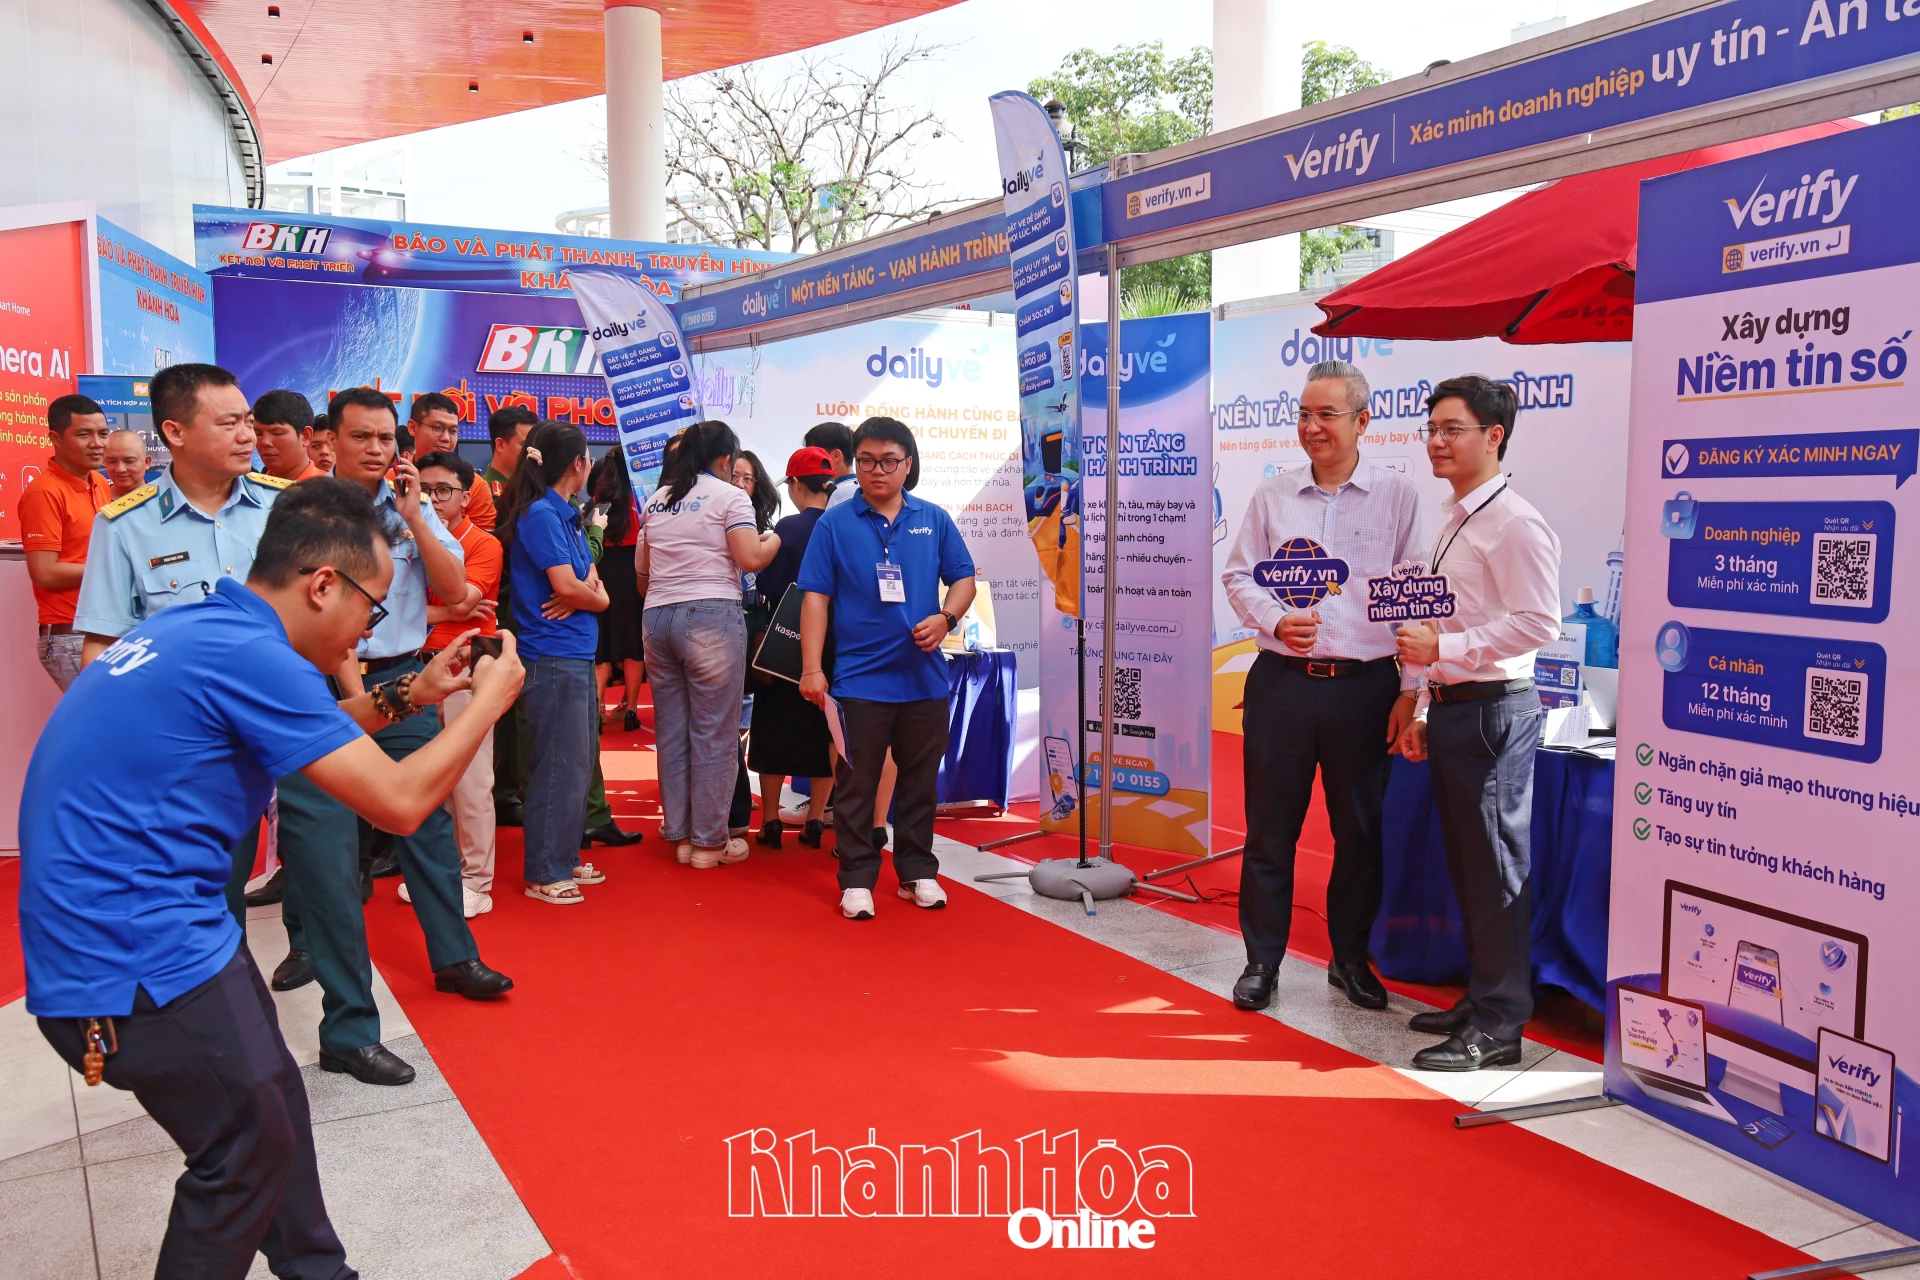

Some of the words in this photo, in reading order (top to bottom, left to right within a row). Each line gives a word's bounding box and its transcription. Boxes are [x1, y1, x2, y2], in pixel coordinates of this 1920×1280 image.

[1410, 117, 1444, 145] Xác
[1447, 105, 1495, 137] minh
[1498, 86, 1562, 124] doanh
[1567, 66, 1645, 108] nghiệp
[1652, 42, 1701, 87] uy
[1711, 20, 1766, 68] tín
[1283, 130, 1381, 182] Verify
[1145, 184, 1192, 210] verify.vn
[1722, 168, 1859, 231] Verify
[393, 231, 447, 253] BÁO
[454, 236, 488, 257] VÀ
[495, 239, 555, 261] PHÁT
[560, 247, 642, 269] THANH,
[649, 248, 725, 274] TRUYỀN
[1750, 237, 1820, 263] verify.vn
[97, 232, 114, 262] BÁO
[114, 241, 127, 268] VÀ
[127, 248, 146, 278] PHÁT
[191, 280, 206, 306] HÌNH
[791, 278, 815, 306] MỘT
[817, 270, 841, 298] NỀN
[842, 263, 876, 292] TẢNG
[889, 256, 918, 285] VẠN
[920, 241, 962, 276] HÀNH
[11, 302, 31, 317] Home
[136, 286, 163, 318] KHÁNH
[164, 298, 180, 326] HÒA
[701, 311, 715, 324] 0155
[1721, 311, 1770, 344] Xây
[1776, 306, 1850, 339] dựng
[50, 348, 71, 380] AI
[1677, 351, 1775, 396] Niềm
[1786, 342, 1842, 387] tin
[1850, 330, 1913, 382] số
[5, 389, 21, 404] sản
[23, 391, 48, 408] phẩm
[107, 398, 122, 406] TÍCH
[620, 392, 635, 402] GIAO
[15, 410, 37, 426] hành
[816, 401, 860, 417] LUÔN
[865, 402, 910, 419] ĐỒNG
[915, 404, 958, 420] HÀNH
[962, 405, 1003, 421] CÙNG
[1219, 393, 1262, 428] NỀN
[15, 431, 37, 447] quốc
[928, 424, 988, 440] CHUYẾN
[992, 428, 1008, 441] ĐI
[1136, 429, 1185, 453] TẢNG
[1239, 438, 1260, 453] tảng
[1262, 438, 1278, 452] đặt
[1280, 438, 1290, 449] vé
[1364, 432, 1387, 446] máy
[1389, 430, 1410, 444] bay
[652, 440, 667, 448] 0155
[949, 449, 976, 461] CÁCH
[1008, 452, 1019, 461] DI
[1698, 446, 1741, 466] ĐĂNG
[1743, 445, 1764, 465] KÝ
[1767, 443, 1801, 464] XÁC
[1804, 445, 1848, 463] MINH
[1850, 443, 1902, 462] NGAY
[1141, 454, 1197, 476] TRÌNH
[922, 478, 939, 488] bay
[941, 477, 952, 486] và
[957, 504, 983, 512] MINH
[985, 504, 1013, 514] BẠCH
[1128, 500, 1145, 510] tàu,
[1146, 500, 1166, 511] máy
[1167, 500, 1184, 511] bay
[1185, 500, 1196, 510] và
[957, 516, 978, 526] ràng
[1128, 514, 1151, 524] trong
[1153, 514, 1157, 522] 1
[1158, 514, 1186, 525] chạm!
[908, 525, 933, 537] Verify
[987, 529, 997, 538] và
[1001, 528, 1024, 538] đánh
[1136, 533, 1165, 544] chóng
[1704, 526, 1749, 542] Doanh
[1751, 526, 1801, 546] nghiệp
[1153, 554, 1186, 565] chuyến
[1714, 554, 1726, 572] 3
[1728, 555, 1778, 579] tháng
[1397, 564, 1425, 577] Verify
[1006, 579, 1018, 588] tất
[1125, 586, 1145, 597] hoạt
[1146, 587, 1157, 596] và
[1159, 589, 1169, 597] an
[1171, 588, 1192, 598] toàn
[1371, 581, 1401, 601] Xây
[1402, 579, 1445, 599] dựng
[1697, 575, 1724, 590] Miễn
[1726, 577, 1745, 594] phí
[1746, 579, 1767, 593] xác
[1770, 580, 1799, 595] minh
[993, 592, 1014, 600] thao
[1016, 591, 1029, 600] tác
[1371, 600, 1407, 619] niềm
[1410, 600, 1430, 616] tin
[1432, 594, 1453, 616] số
[1137, 653, 1151, 662] TẠI
[1153, 653, 1173, 664] ĐÂY
[1708, 655, 1726, 671] Cá
[1729, 658, 1764, 676] nhân
[1831, 653, 1842, 661] QR
[1701, 682, 1719, 700] 12
[1723, 685, 1771, 711] tháng
[1688, 702, 1715, 718] Miễn
[1716, 705, 1734, 722] phí
[1736, 709, 1757, 725] xác
[1759, 714, 1788, 729] minh
[1129, 728, 1145, 737] Google
[1145, 730, 1155, 738] Play
[1125, 758, 1149, 768] NGAY
[1130, 771, 1160, 788] 0155
[1658, 751, 1696, 774] Ngăn
[1699, 760, 1736, 782] chặn
[1740, 766, 1764, 787] giả
[1768, 774, 1803, 796] mạo
[1808, 779, 1874, 811] thương
[1878, 791, 1920, 818] hiệu
[1658, 787, 1692, 813] Tăng
[1695, 800, 1714, 818] uy
[1717, 800, 1737, 819] tín
[1656, 824, 1682, 846] Tạo
[1685, 836, 1704, 854] sự
[1707, 838, 1726, 856] tin
[1730, 845, 1778, 873] tưởng
[1782, 856, 1835, 885] khách
[1839, 870, 1886, 901] hàng
[1743, 969, 1773, 987] Verify
[1826, 1053, 1882, 1087] Verify
